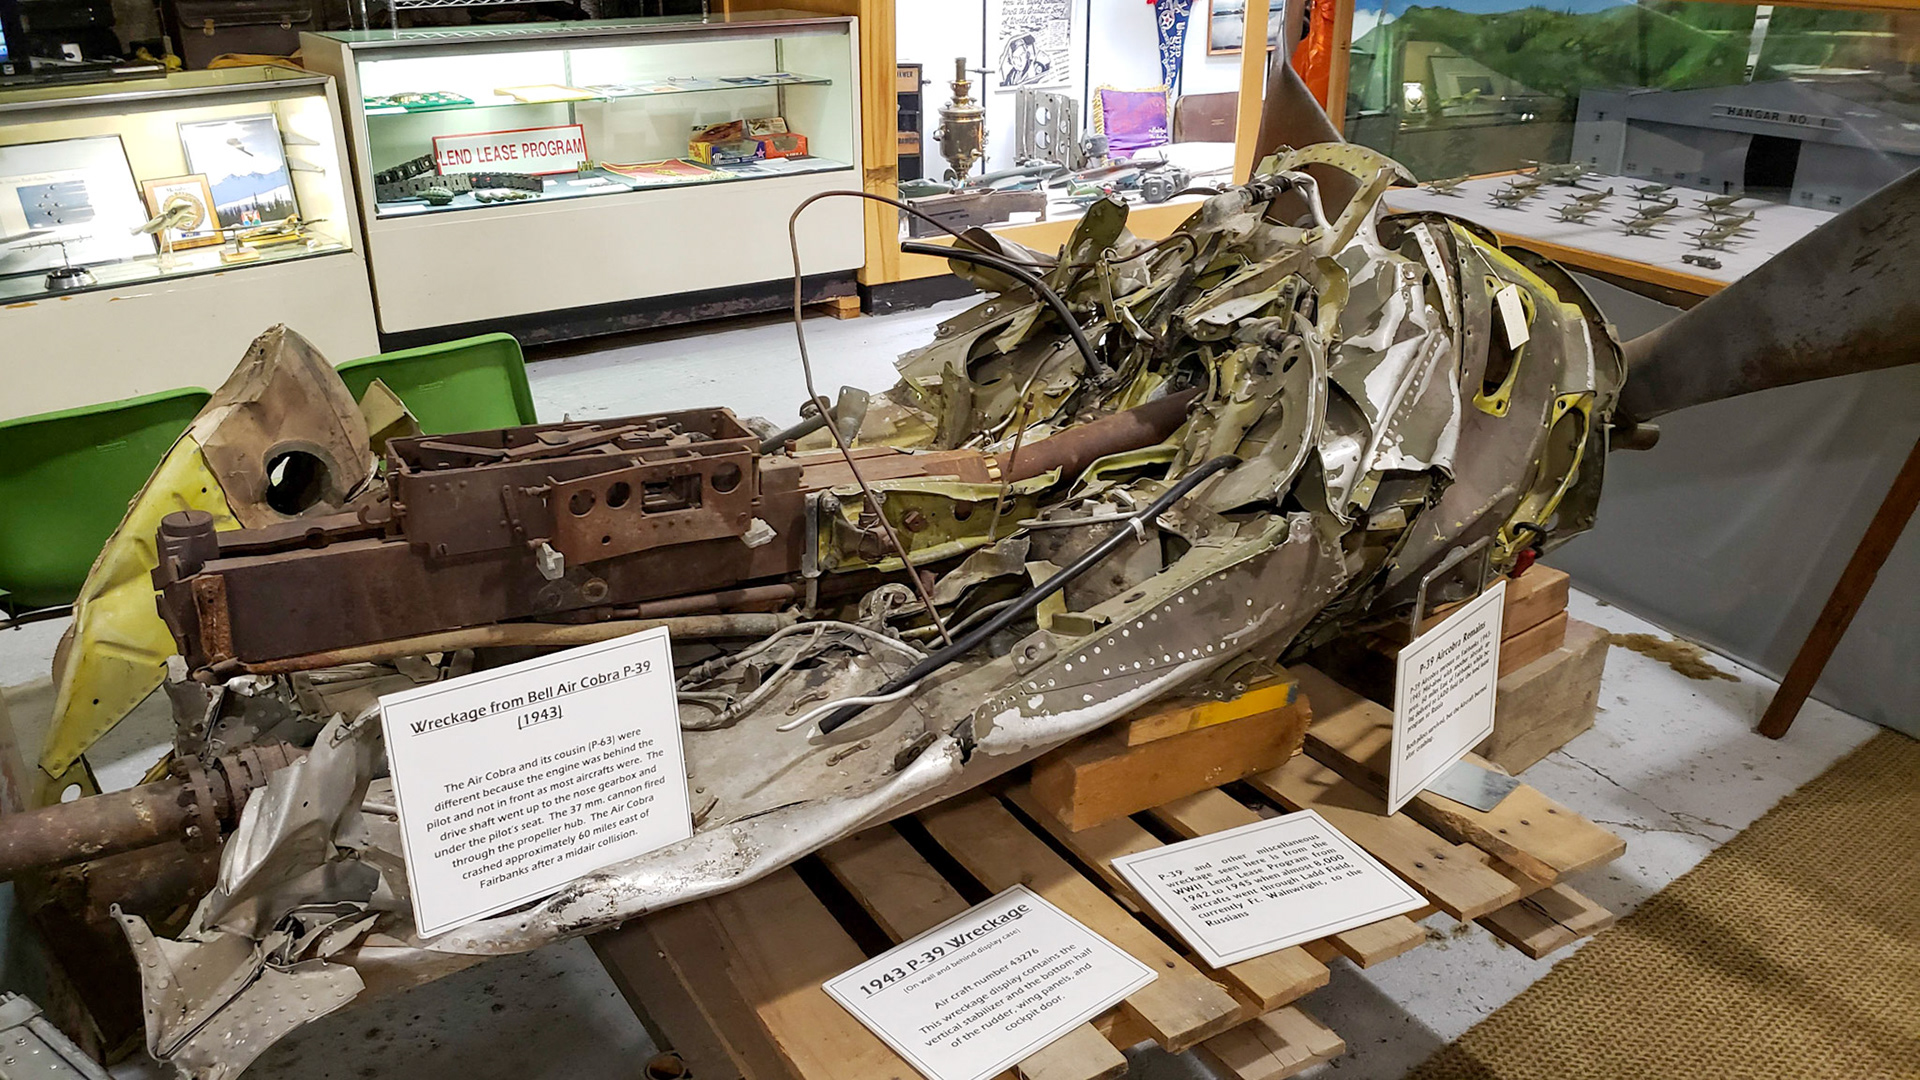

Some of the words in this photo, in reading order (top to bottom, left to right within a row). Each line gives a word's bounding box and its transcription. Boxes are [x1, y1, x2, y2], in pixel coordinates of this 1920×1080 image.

[1727, 106, 1780, 121] HANGAR
[1788, 114, 1810, 125] NO.
[439, 149, 472, 166] LEND
[476, 144, 518, 163] LEASE
[521, 138, 584, 159] PROGRAM
[1463, 621, 1485, 643] Remains
[410, 707, 486, 733] Wreckage
[490, 697, 523, 713] from
[528, 686, 553, 703] Bell
[557, 681, 576, 695] Air
[581, 671, 619, 688] Cobra
[624, 661, 650, 677] P-39
[435, 792, 480, 811] different
[483, 780, 524, 797] because
[527, 774, 543, 783] the
[546, 763, 579, 777] engine
[582, 756, 601, 766] was
[603, 743, 635, 760] behind
[639, 740, 653, 748] the
[444, 783, 464, 793] The
[467, 776, 482, 787] Air
[486, 767, 516, 780] Cobra
[519, 759, 538, 771] and
[541, 756, 552, 764] its
[555, 746, 585, 760] cousin
[618, 729, 641, 740] were
[427, 817, 451, 832] pilot
[454, 808, 473, 821] and
[477, 803, 494, 814] not
[497, 800, 507, 808] in
[509, 790, 534, 804] front
[537, 787, 547, 795] as
[550, 778, 574, 791] most
[576, 766, 614, 782] aircrafts
[616, 758, 642, 769] were.
[647, 750, 663, 759] The
[435, 843, 465, 858] under
[469, 837, 485, 847] the
[522, 818, 544, 830] seat.
[549, 810, 567, 820] The
[571, 803, 581, 814] 37
[585, 798, 605, 809] mm.
[608, 785, 642, 801] cannon
[645, 776, 665, 789] fired
[440, 828, 466, 841] drive
[470, 818, 495, 832] shaft
[498, 809, 524, 822] went
[527, 805, 539, 813] up
[542, 800, 552, 808] to
[555, 794, 570, 804] the
[573, 786, 596, 798] nose
[599, 773, 636, 792] gearbox
[639, 765, 656, 777] and
[452, 848, 495, 867] through
[498, 842, 514, 852] the
[518, 826, 561, 848] propeller
[564, 819, 585, 830] hub.
[590, 811, 608, 820] The
[611, 805, 624, 815] Air
[627, 795, 654, 808] Cobra
[463, 859, 502, 879] crashed
[506, 836, 575, 865] approximately
[579, 830, 590, 840] 60
[593, 822, 616, 835] miles
[619, 814, 638, 825] east
[640, 809, 649, 818] of
[480, 867, 528, 888] Fairbanks
[532, 858, 554, 871] after
[566, 843, 595, 859] midair
[598, 830, 637, 847] collision.
[1158, 870, 1182, 880] P-39
[1194, 862, 1212, 871] and
[1221, 854, 1246, 864] other
[1256, 835, 1319, 854] miscellaneous
[1166, 873, 1213, 887] wreckage
[1218, 866, 1240, 874] seen
[1243, 859, 1266, 867] here
[1283, 847, 1307, 856] from
[1173, 883, 1203, 895] WWII
[1207, 876, 1233, 886] Lend
[1236, 869, 1264, 878] Lease
[1267, 856, 1309, 870] Program
[1312, 849, 1336, 857] from
[1183, 891, 1210, 902] 1942
[1226, 880, 1252, 891] 1945
[1254, 874, 1280, 883] when
[1282, 864, 1313, 875] almost
[1313, 855, 1344, 866] 8,000
[1190, 897, 1231, 911] aircrafts
[1233, 889, 1258, 898] went
[1260, 877, 1299, 891] through
[1300, 869, 1325, 880] Ladd
[1326, 862, 1354, 872] Field,
[1198, 903, 1243, 918] currently
[1266, 881, 1327, 899] Wainwright,
[1205, 912, 1249, 926] Russians
[860, 968, 906, 994] 1943
[906, 947, 945, 971] P-39
[944, 905, 1029, 948] Wreckage
[919, 974, 935, 984] wall
[937, 965, 951, 975] and
[951, 952, 976, 967] behind
[977, 939, 1002, 953] display
[935, 999, 949, 1009] Air
[951, 986, 973, 999] craft
[974, 965, 1009, 987] number
[1010, 949, 1039, 965] 43276
[919, 1021, 942, 1033] This
[942, 995, 989, 1021] wreckage
[990, 975, 1022, 995] display
[1022, 954, 1060, 976] contains
[1060, 945, 1076, 954] the
[925, 1023, 962, 1046] vertical
[963, 999, 1004, 1025] stabilizer
[1006, 987, 1024, 1000] and
[1024, 979, 1041, 989] the
[1040, 960, 1074, 980] bottom
[1073, 948, 1092, 960] half
[951, 1038, 962, 1047] of
[962, 1029, 981, 1040] the
[981, 1009, 1017, 1030] rudder,
[1016, 994, 1042, 1008] wing
[1041, 976, 1074, 996] panels,
[1074, 963, 1092, 975] and
[1005, 1009, 1040, 1031] cockpit
[1040, 996, 1065, 1010] door.
